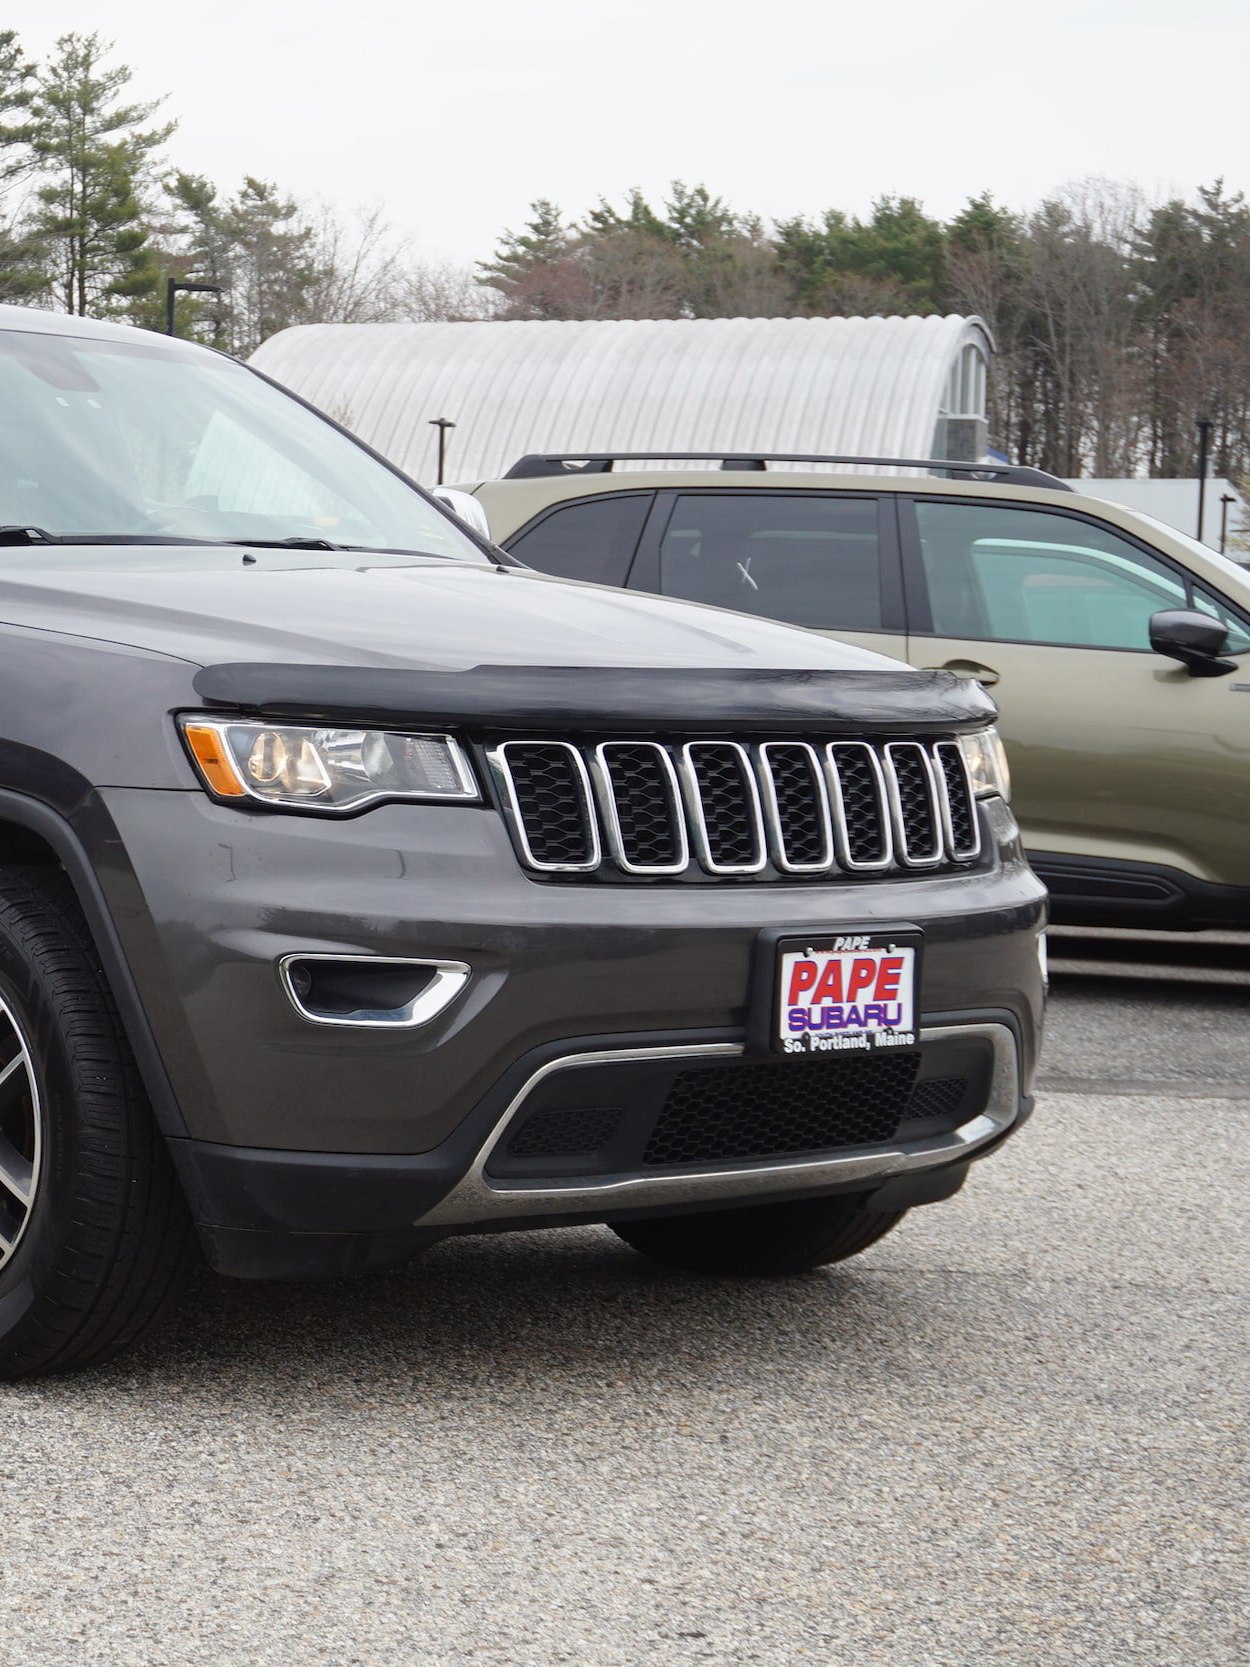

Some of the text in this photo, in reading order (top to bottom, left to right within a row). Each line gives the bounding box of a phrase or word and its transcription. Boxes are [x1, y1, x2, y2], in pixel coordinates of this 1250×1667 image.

[833, 936, 871, 951] PAPE
[788, 957, 905, 1006] PAPE
[788, 1003, 902, 1032] SUBARU
[784, 1039, 806, 1053] So.
[810, 1034, 871, 1051] Portland,
[875, 1032, 915, 1047] Maine
